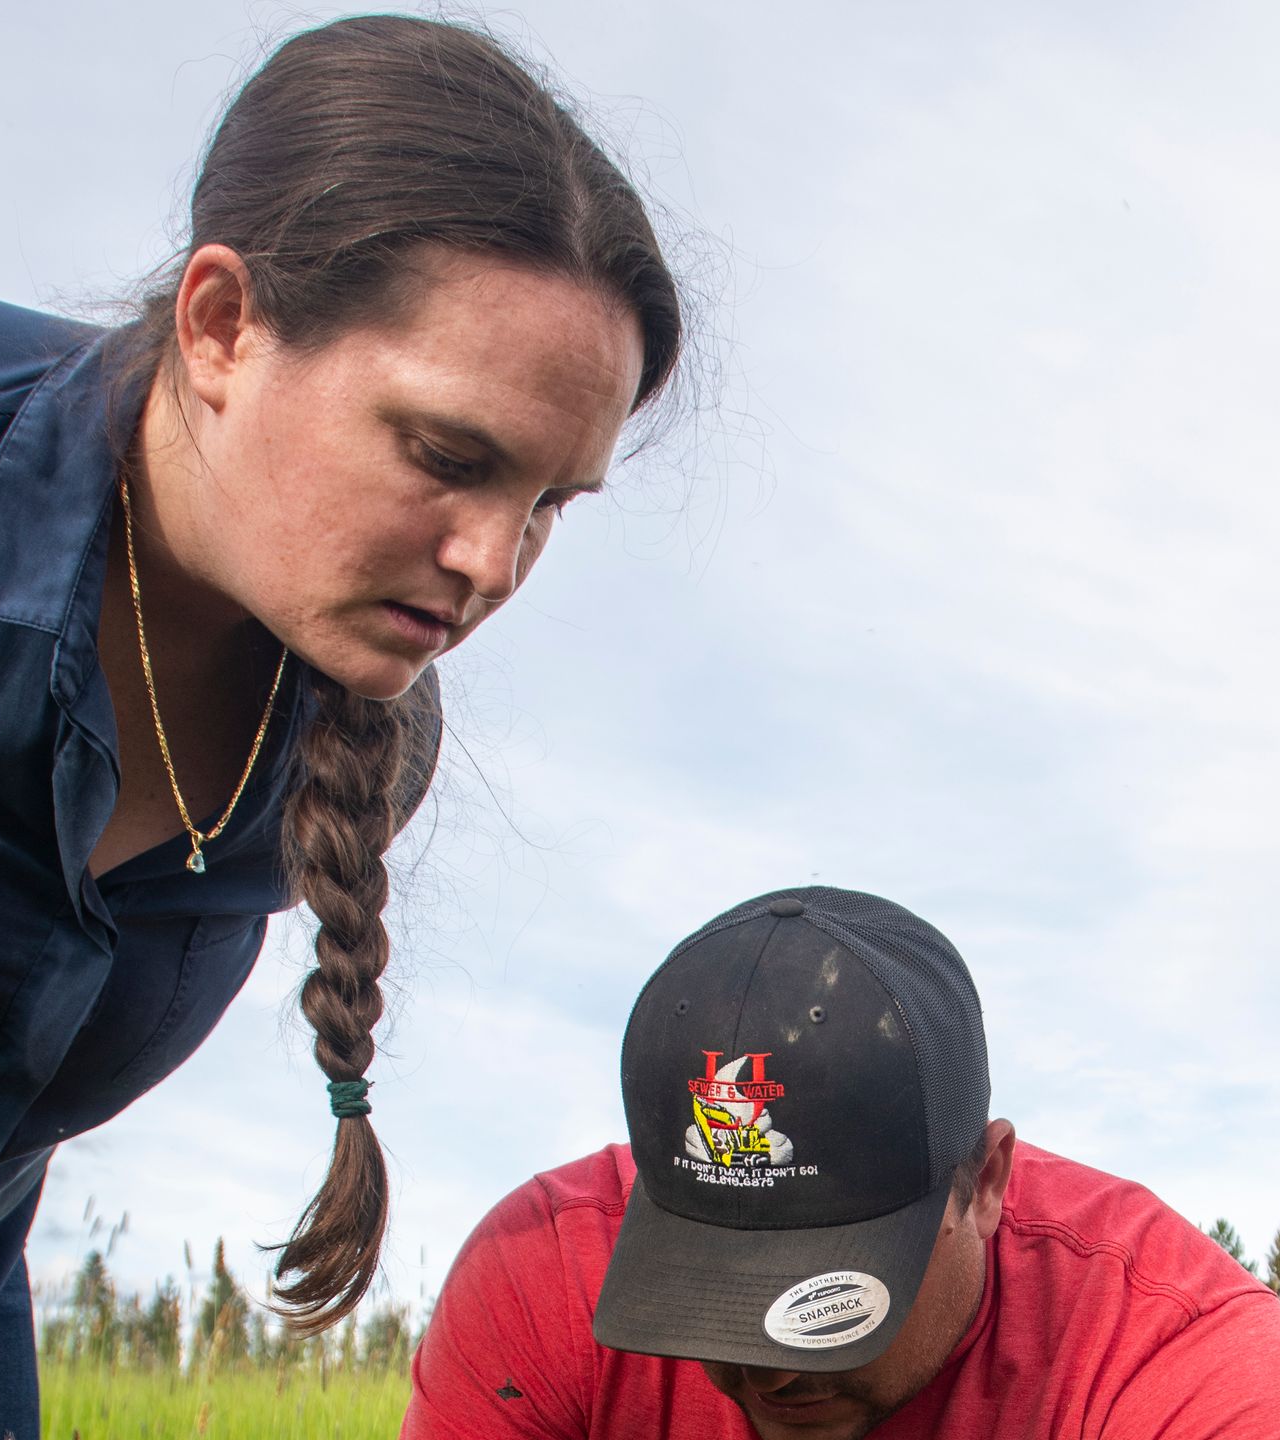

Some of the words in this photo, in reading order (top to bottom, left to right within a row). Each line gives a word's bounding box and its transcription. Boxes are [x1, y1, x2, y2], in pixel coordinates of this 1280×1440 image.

[687, 1079, 721, 1097] SEWER
[727, 1086, 736, 1099] &
[742, 1084, 785, 1098] WATER
[682, 1159, 689, 1169] IT
[690, 1160, 717, 1174] DON'T
[751, 1167, 762, 1178] IT
[765, 1166, 796, 1177] DON'T
[789, 1287, 804, 1298] THE
[808, 1275, 853, 1289] AUTHENTIC
[798, 1297, 862, 1324] SNAPBACK
[802, 1337, 838, 1345] YUPOONG
[841, 1330, 860, 1342] SINCE
